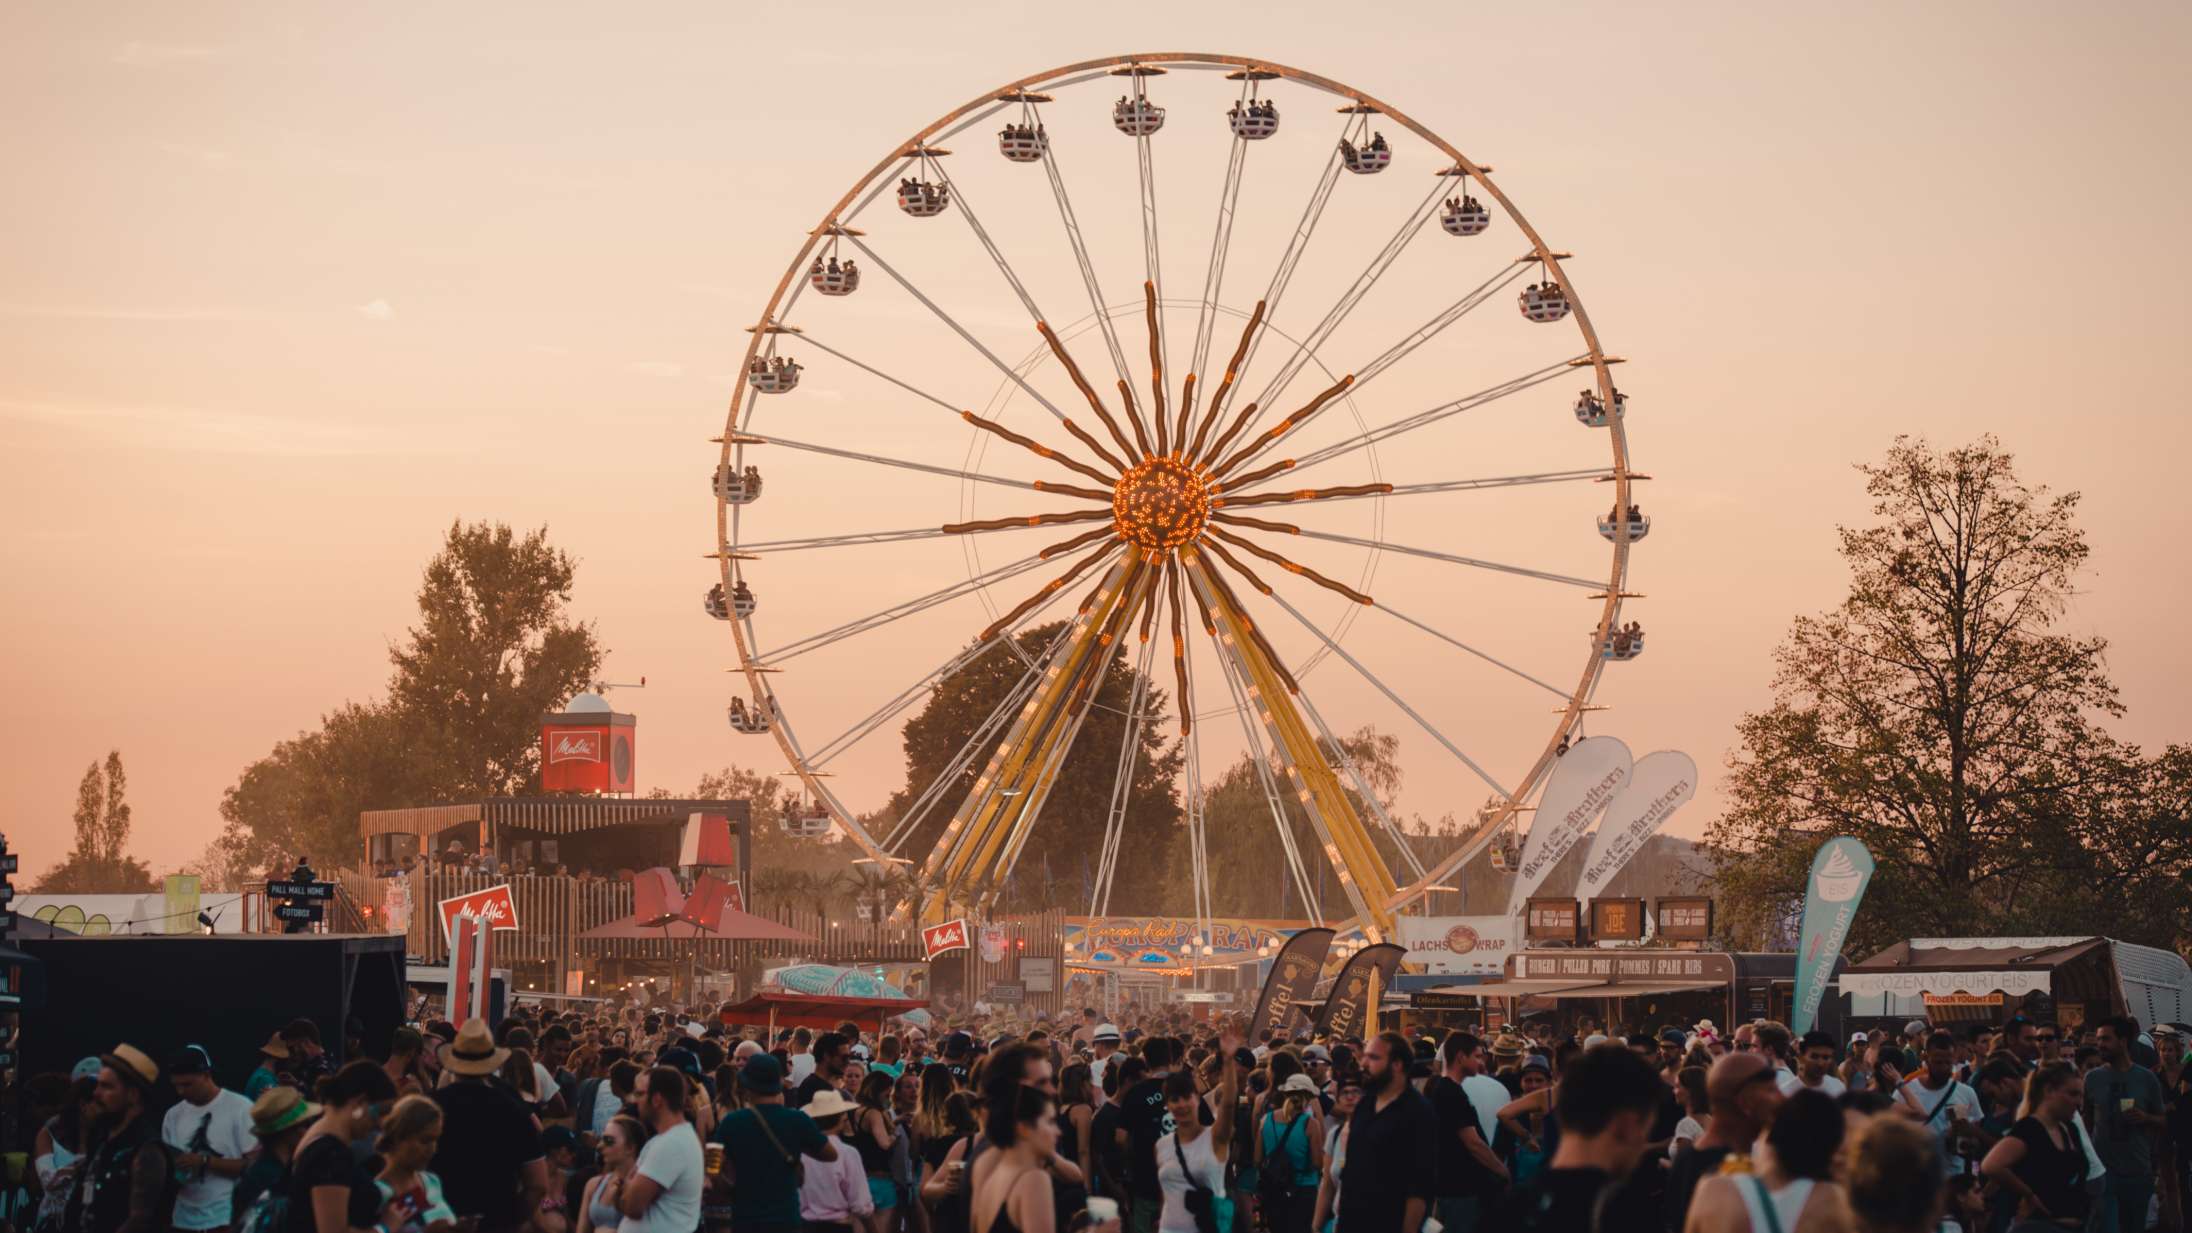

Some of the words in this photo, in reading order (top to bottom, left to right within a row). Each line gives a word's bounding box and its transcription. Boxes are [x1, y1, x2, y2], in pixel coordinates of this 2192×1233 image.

[1565, 766, 1624, 827] Brothers
[1629, 779, 1689, 837] Brothers
[271, 885, 286, 894] PALL
[288, 886, 305, 895] MALL
[307, 887, 324, 896] HOME
[1828, 882, 1849, 896] EIS
[1605, 913, 1627, 933] JOE
[1411, 940, 1449, 952] LACHS
[1474, 939, 1506, 951] WRAP
[1528, 959, 1556, 974] BURGER
[1562, 959, 1589, 974] PULLED
[1592, 959, 1611, 974] PORK
[1618, 959, 1650, 975] POMMES
[1657, 959, 1681, 975] SPARE
[1684, 959, 1702, 975] RIBS
[1803, 958, 1831, 1015] FROZEN
[1823, 904, 1851, 959] YOGURT
[1860, 975, 1923, 989] FROZEN
[1926, 973, 1996, 989] YOGURT
[1926, 995, 1955, 1004] FROZEN
